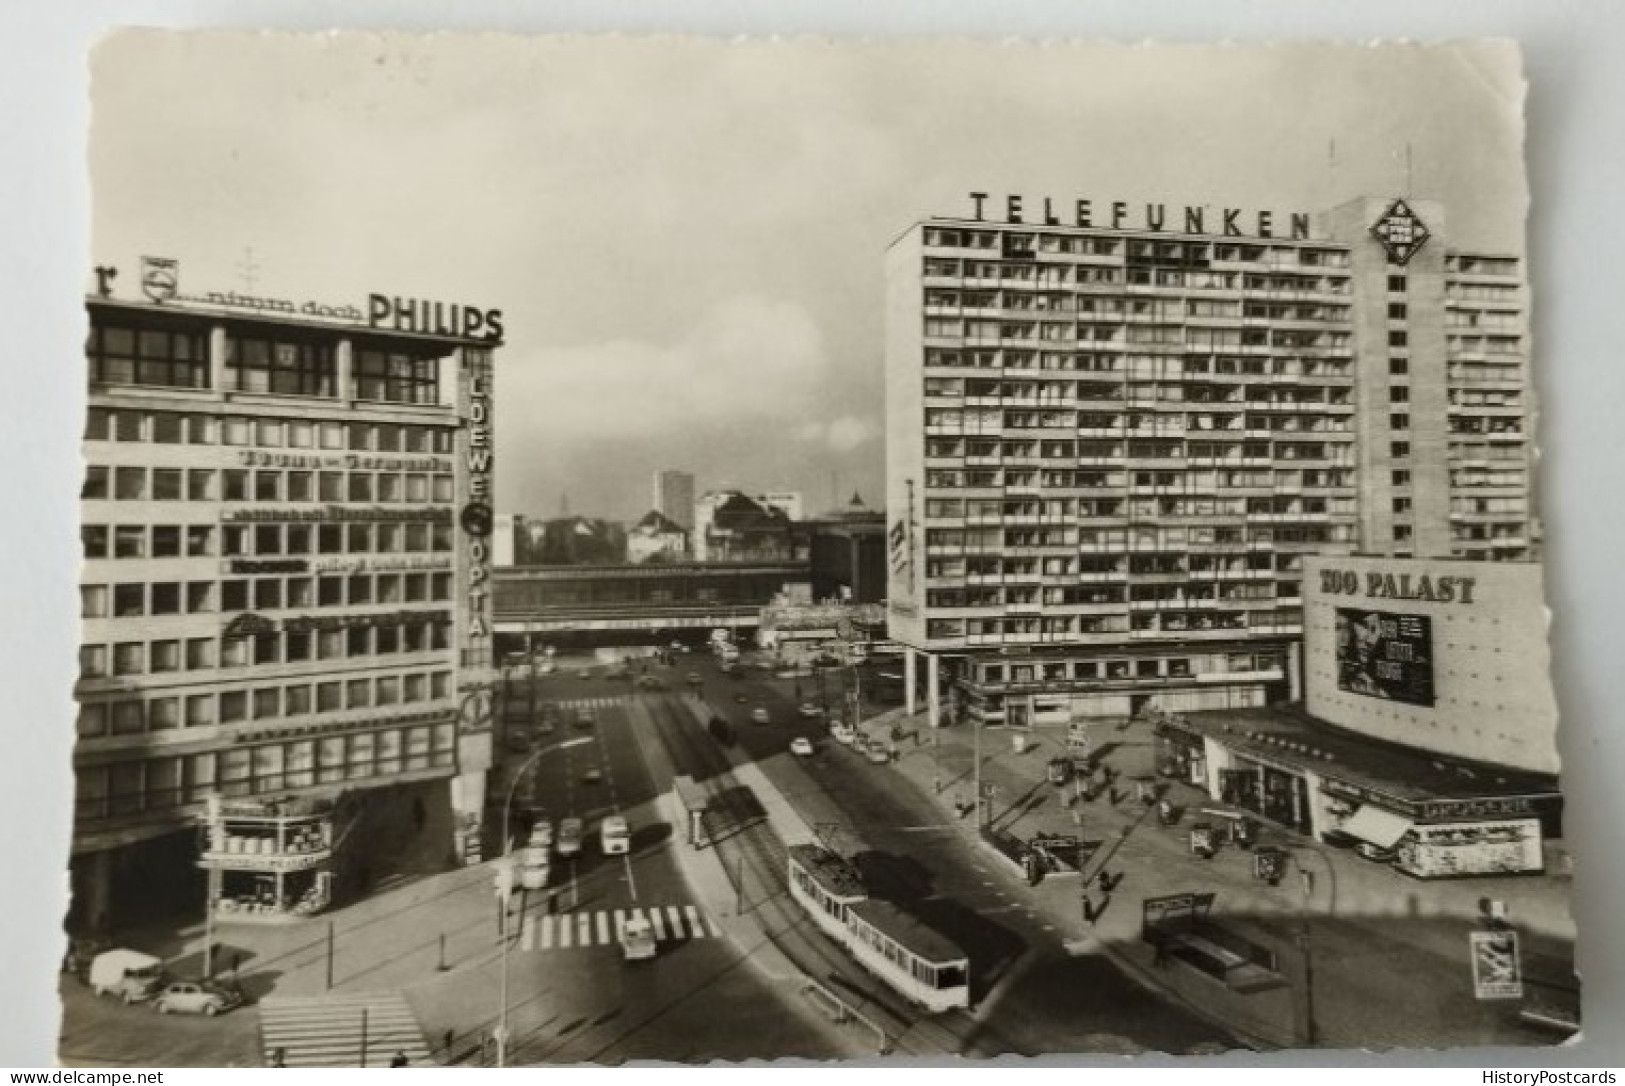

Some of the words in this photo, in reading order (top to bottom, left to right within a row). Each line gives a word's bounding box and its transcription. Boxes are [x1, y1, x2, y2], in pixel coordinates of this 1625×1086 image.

[969, 191, 1312, 240] TELEFUNKEN
[301, 300, 363, 320] doch
[368, 292, 504, 342] PHILIPS
[470, 379, 492, 495] LOEWE
[470, 545, 489, 636] OPTA
[1366, 572, 1476, 603] PALAST
